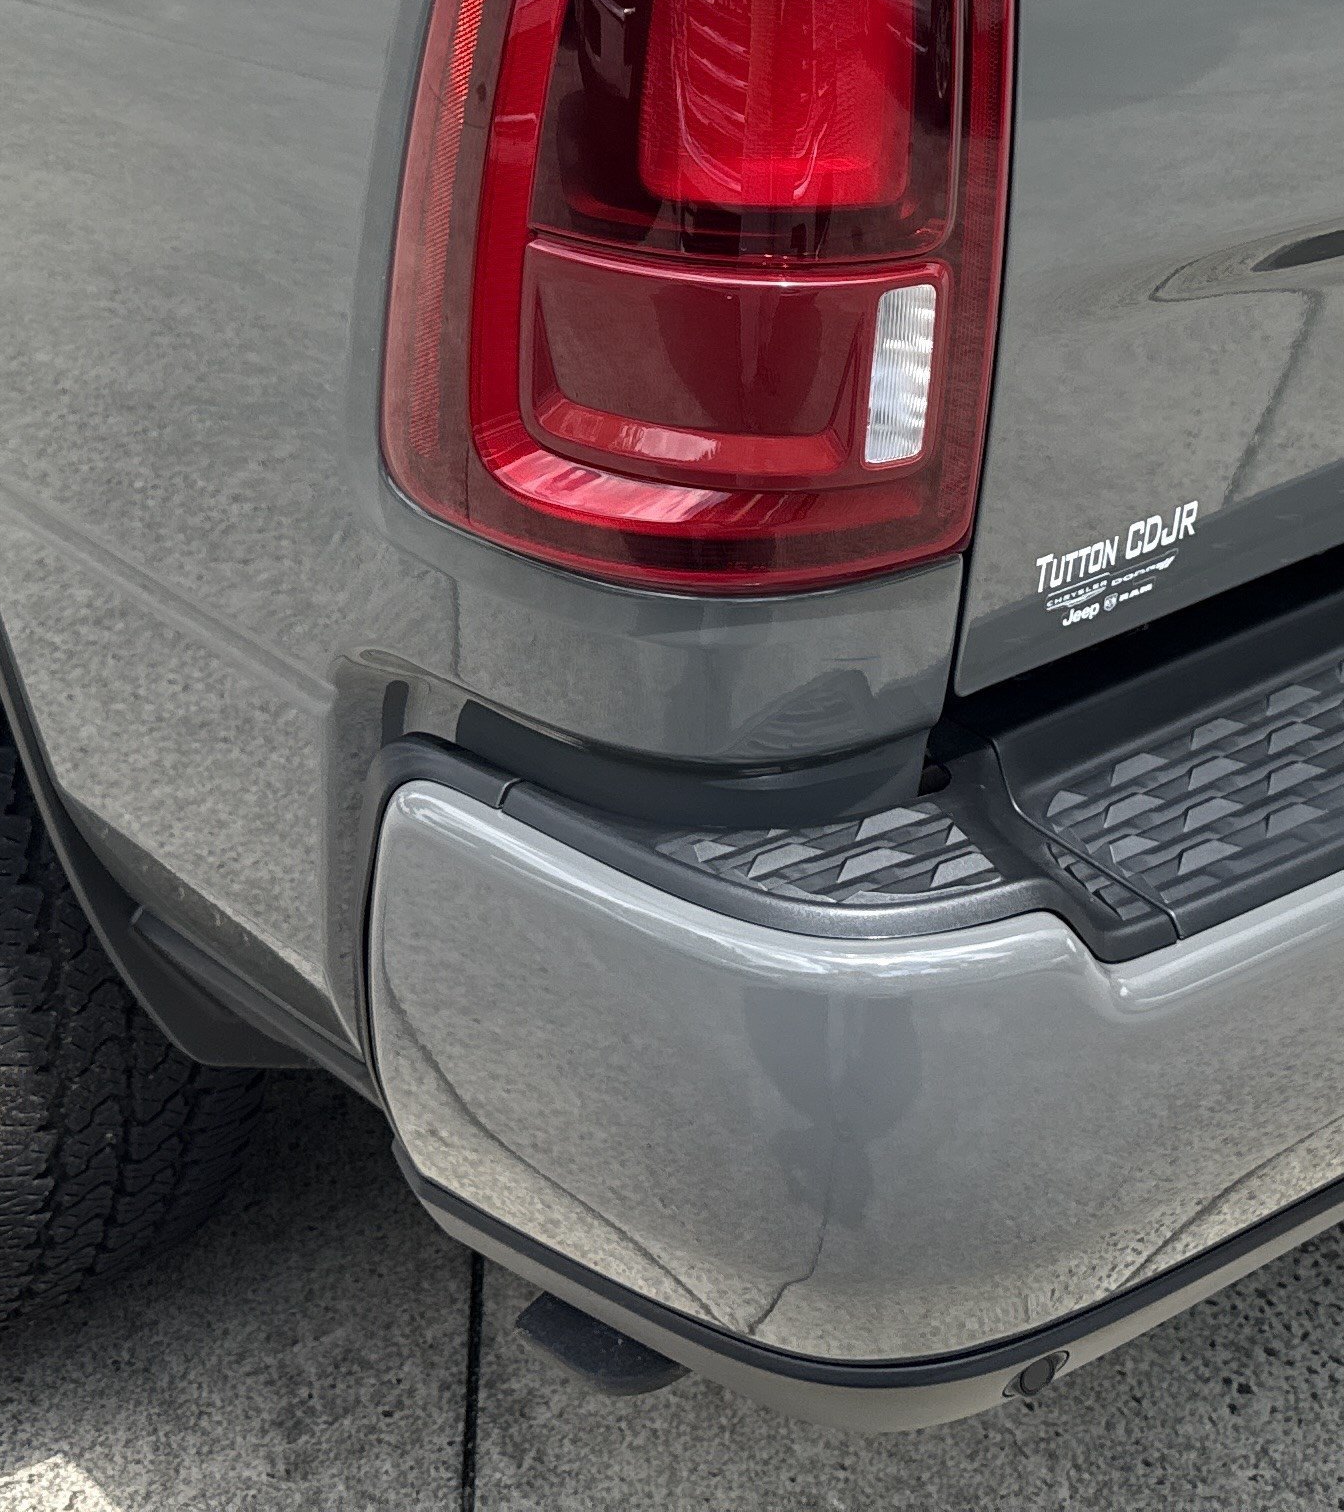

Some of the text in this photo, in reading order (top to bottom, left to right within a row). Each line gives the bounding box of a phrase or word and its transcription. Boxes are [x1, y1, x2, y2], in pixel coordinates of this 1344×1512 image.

[1036, 500, 1199, 593] TUTTON CDJR
[1046, 579, 1108, 608] CHRYSLER
[1062, 583, 1154, 627] Jeep RAM
